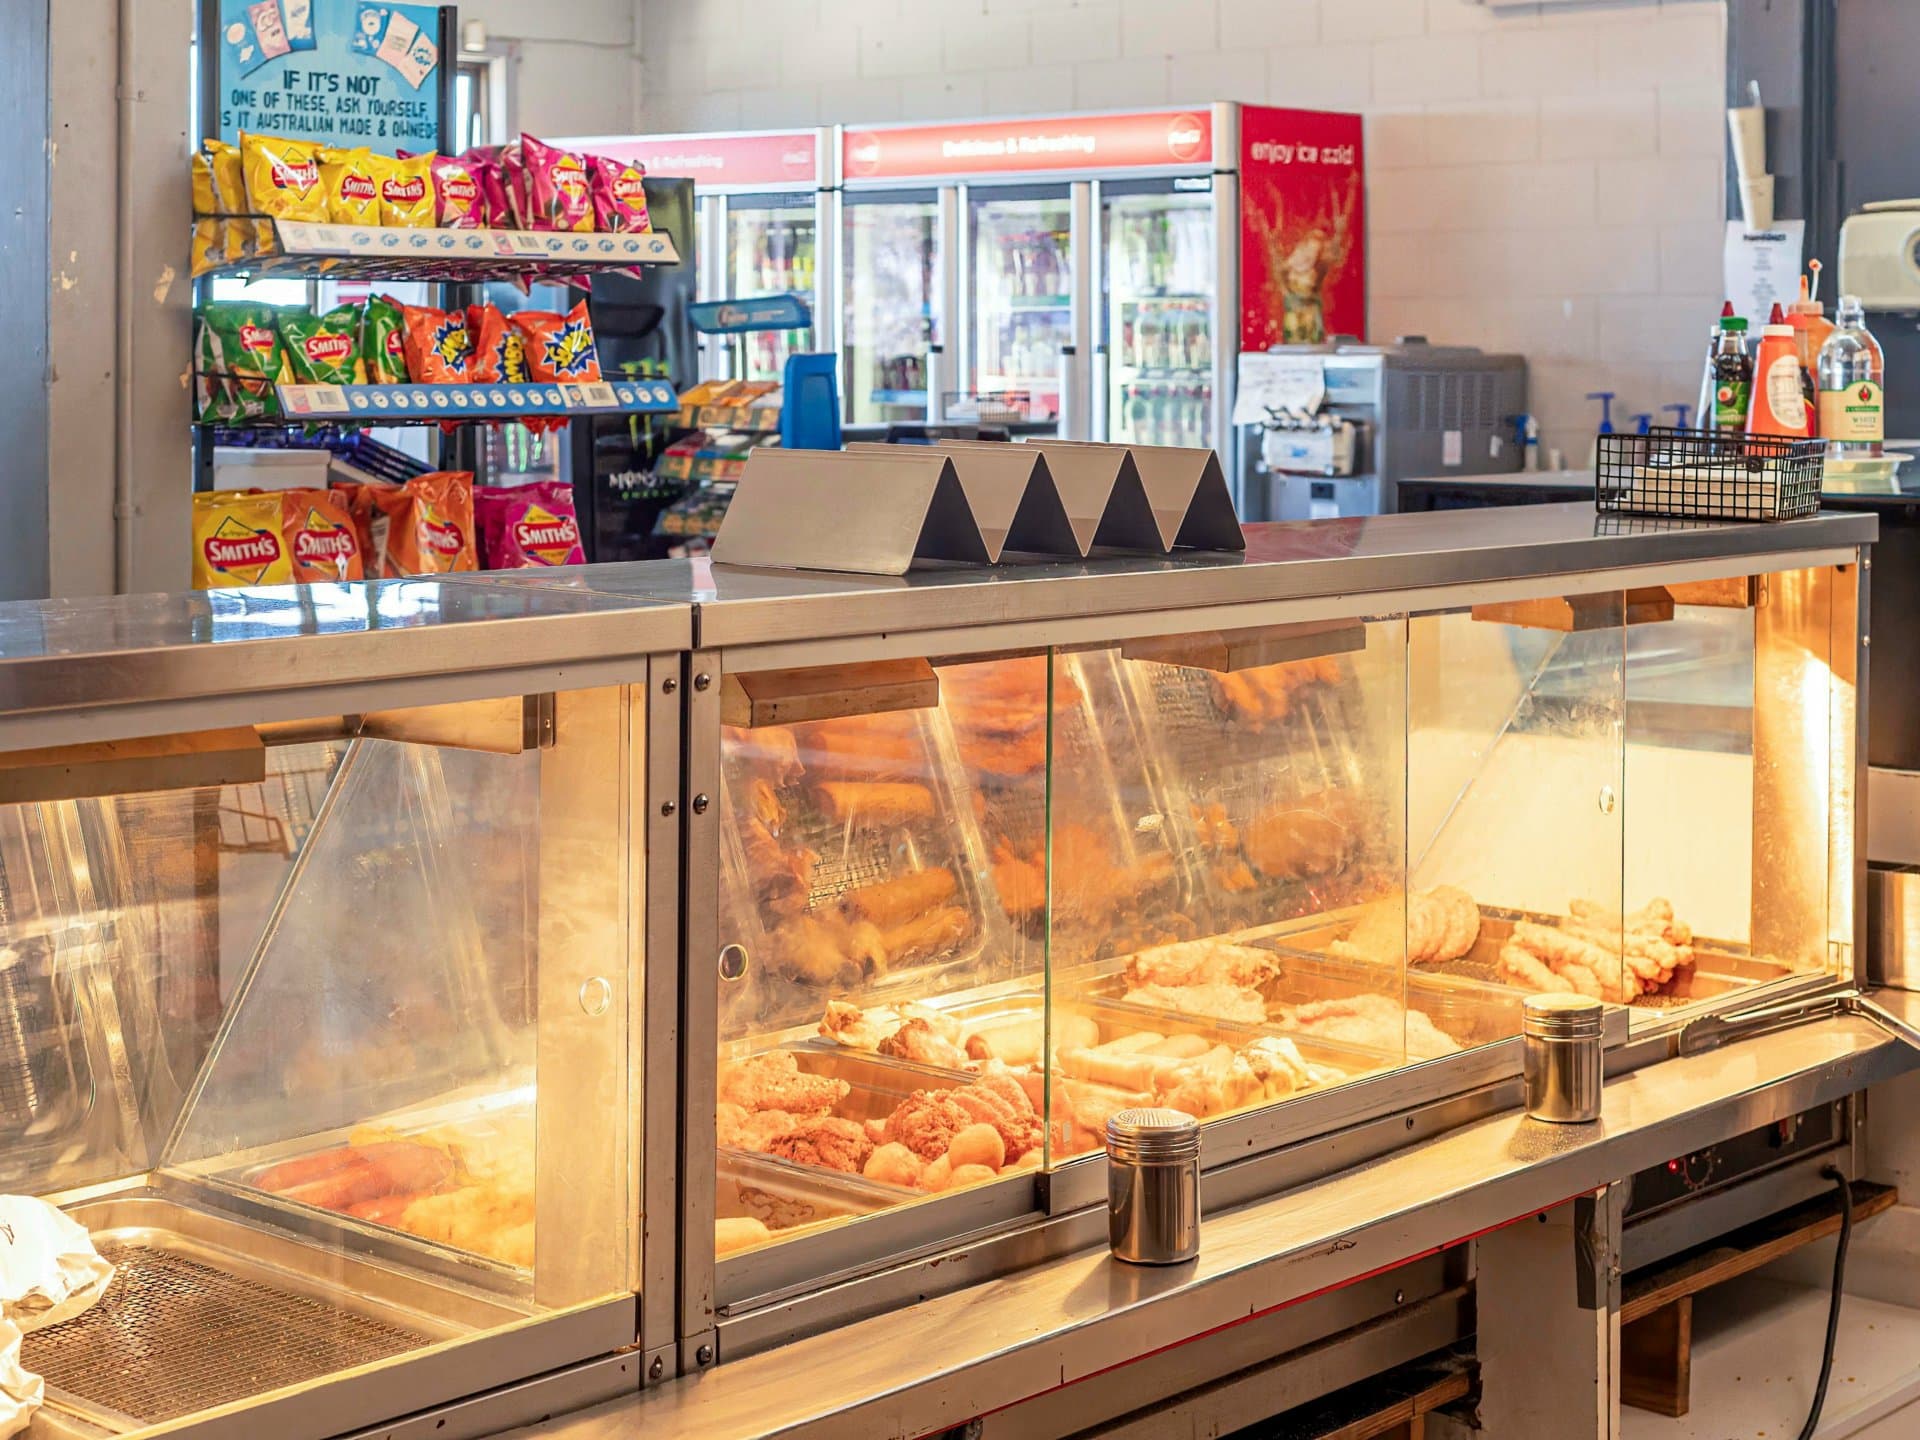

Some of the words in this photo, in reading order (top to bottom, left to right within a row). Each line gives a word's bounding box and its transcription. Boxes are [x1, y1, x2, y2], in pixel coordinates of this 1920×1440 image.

[283, 70, 300, 90] IF
[308, 71, 339, 92] IT'S
[347, 76, 381, 96] NOT
[231, 89, 256, 107] ONE
[264, 91, 280, 108] OF
[287, 93, 329, 114] THESE,
[336, 96, 360, 114] ASK
[367, 99, 429, 121] YOURSELF,
[222, 111, 231, 127] S
[238, 112, 249, 128] IT
[257, 113, 333, 133] AUSTRALIAN
[340, 118, 372, 136] MADE
[378, 121, 386, 136] &
[1251, 138, 1295, 164] enjoy
